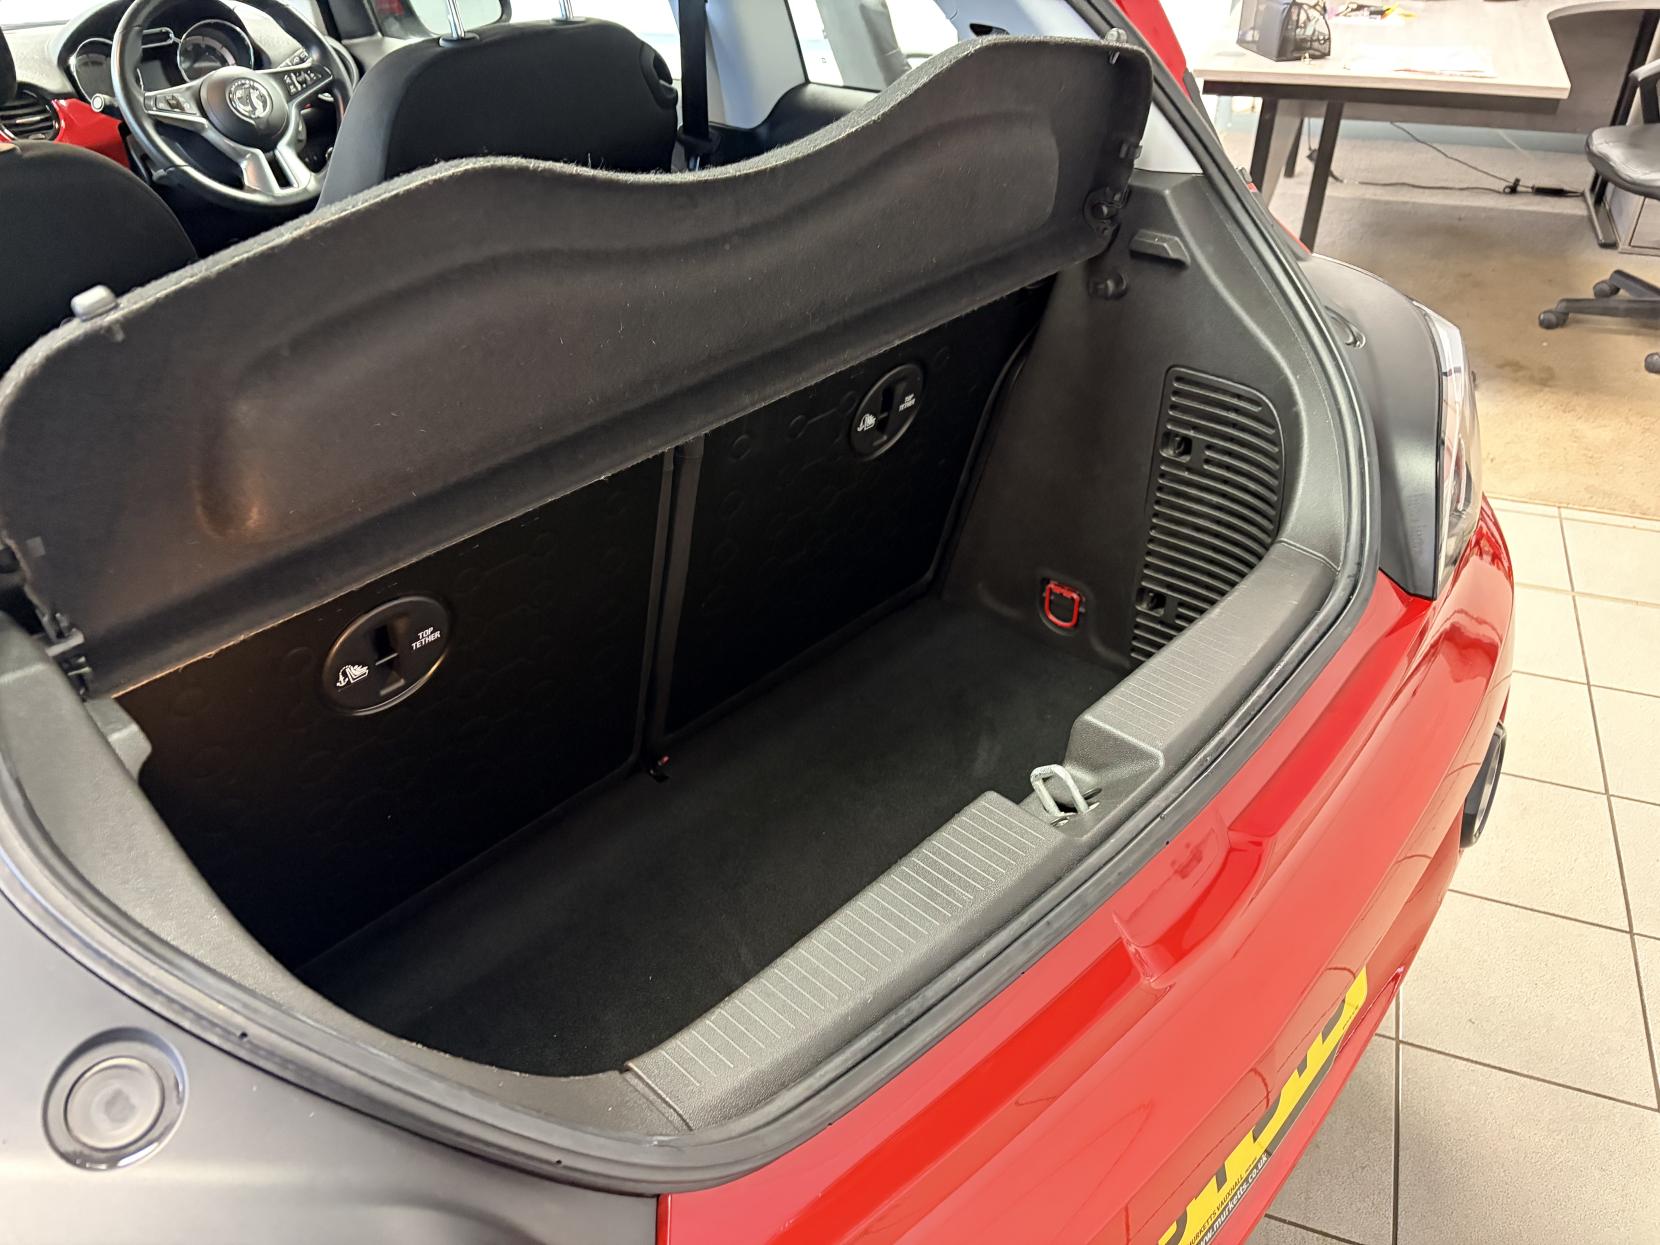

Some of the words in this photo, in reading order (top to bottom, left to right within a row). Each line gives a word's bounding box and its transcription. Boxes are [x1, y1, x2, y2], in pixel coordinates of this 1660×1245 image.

[411, 630, 441, 651] TETHER
[417, 626, 434, 640] TOP
[1216, 1173, 1243, 1211] VAUXHALL
